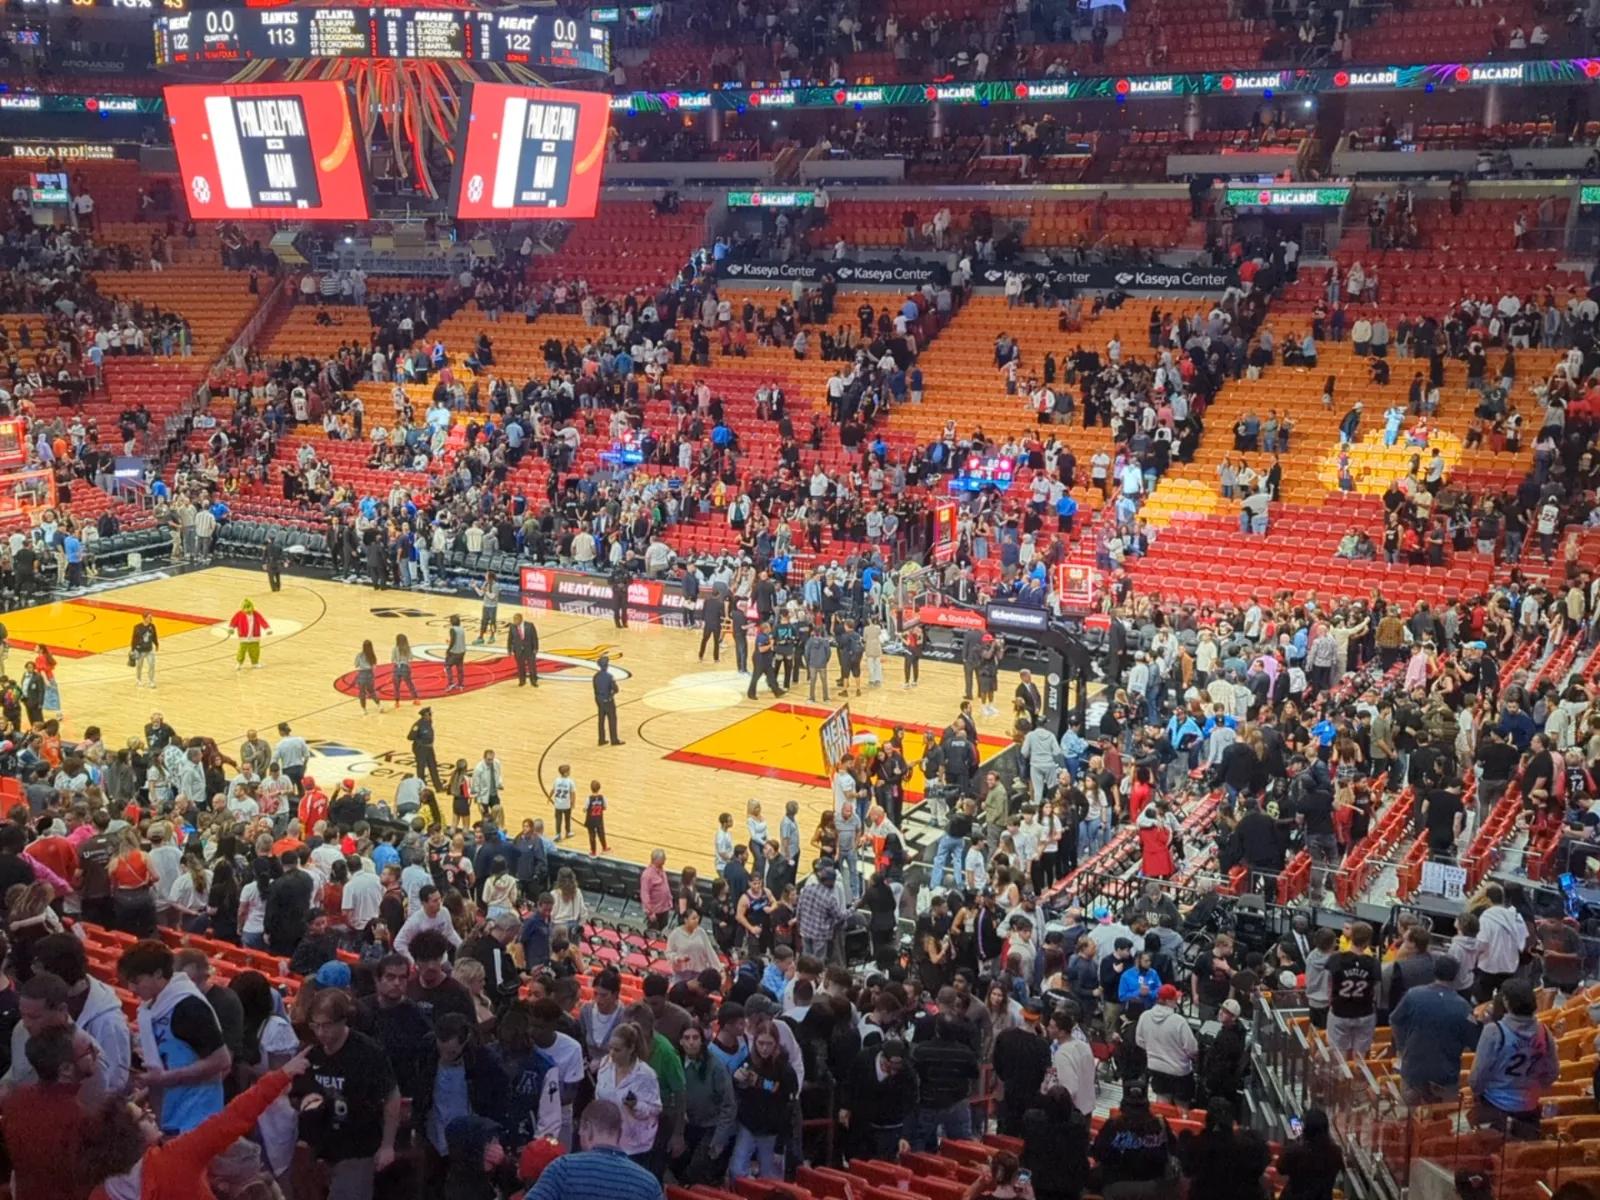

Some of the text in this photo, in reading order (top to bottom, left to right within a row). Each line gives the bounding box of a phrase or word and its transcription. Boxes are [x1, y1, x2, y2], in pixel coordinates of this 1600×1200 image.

[168, 11, 192, 30] HEAT
[206, 10, 234, 33] 0.0
[261, 11, 298, 25] HAWKS
[315, 10, 355, 19] ATLANTA
[414, 11, 453, 21] MIAMI
[498, 14, 538, 31] HEAT
[267, 28, 296, 45] 113
[554, 19, 577, 41] 0.0
[173, 33, 189, 50] 122
[505, 33, 531, 51] 122
[1350, 70, 1397, 85] BACARDÍ
[1472, 64, 1523, 80] BACARDÍ
[1131, 78, 1172, 91] BACARDÍ
[1236, 74, 1280, 88] BACARDÍ
[760, 91, 794, 104] BACARDÍ
[847, 87, 882, 100] BACARDÍ
[938, 84, 975, 98] BACARDÍ
[1029, 84, 1068, 97] BACARDÍ
[100, 97, 137, 110] BACARDÍ
[679, 93, 711, 106] BACARDÍ
[762, 193, 795, 205] BACARDÍ
[1273, 190, 1316, 204] BACARDÍ
[743, 263, 816, 279] Kaseya Center
[854, 267, 933, 282] Kaseya Center
[1135, 274, 1228, 288] Kaseya Center
[558, 580, 590, 596] HEAT
[991, 609, 1042, 624] ticketmaster
[1049, 686, 1058, 710] AT&T
[555, 789, 569, 799] 22
[1339, 980, 1368, 998] 22
